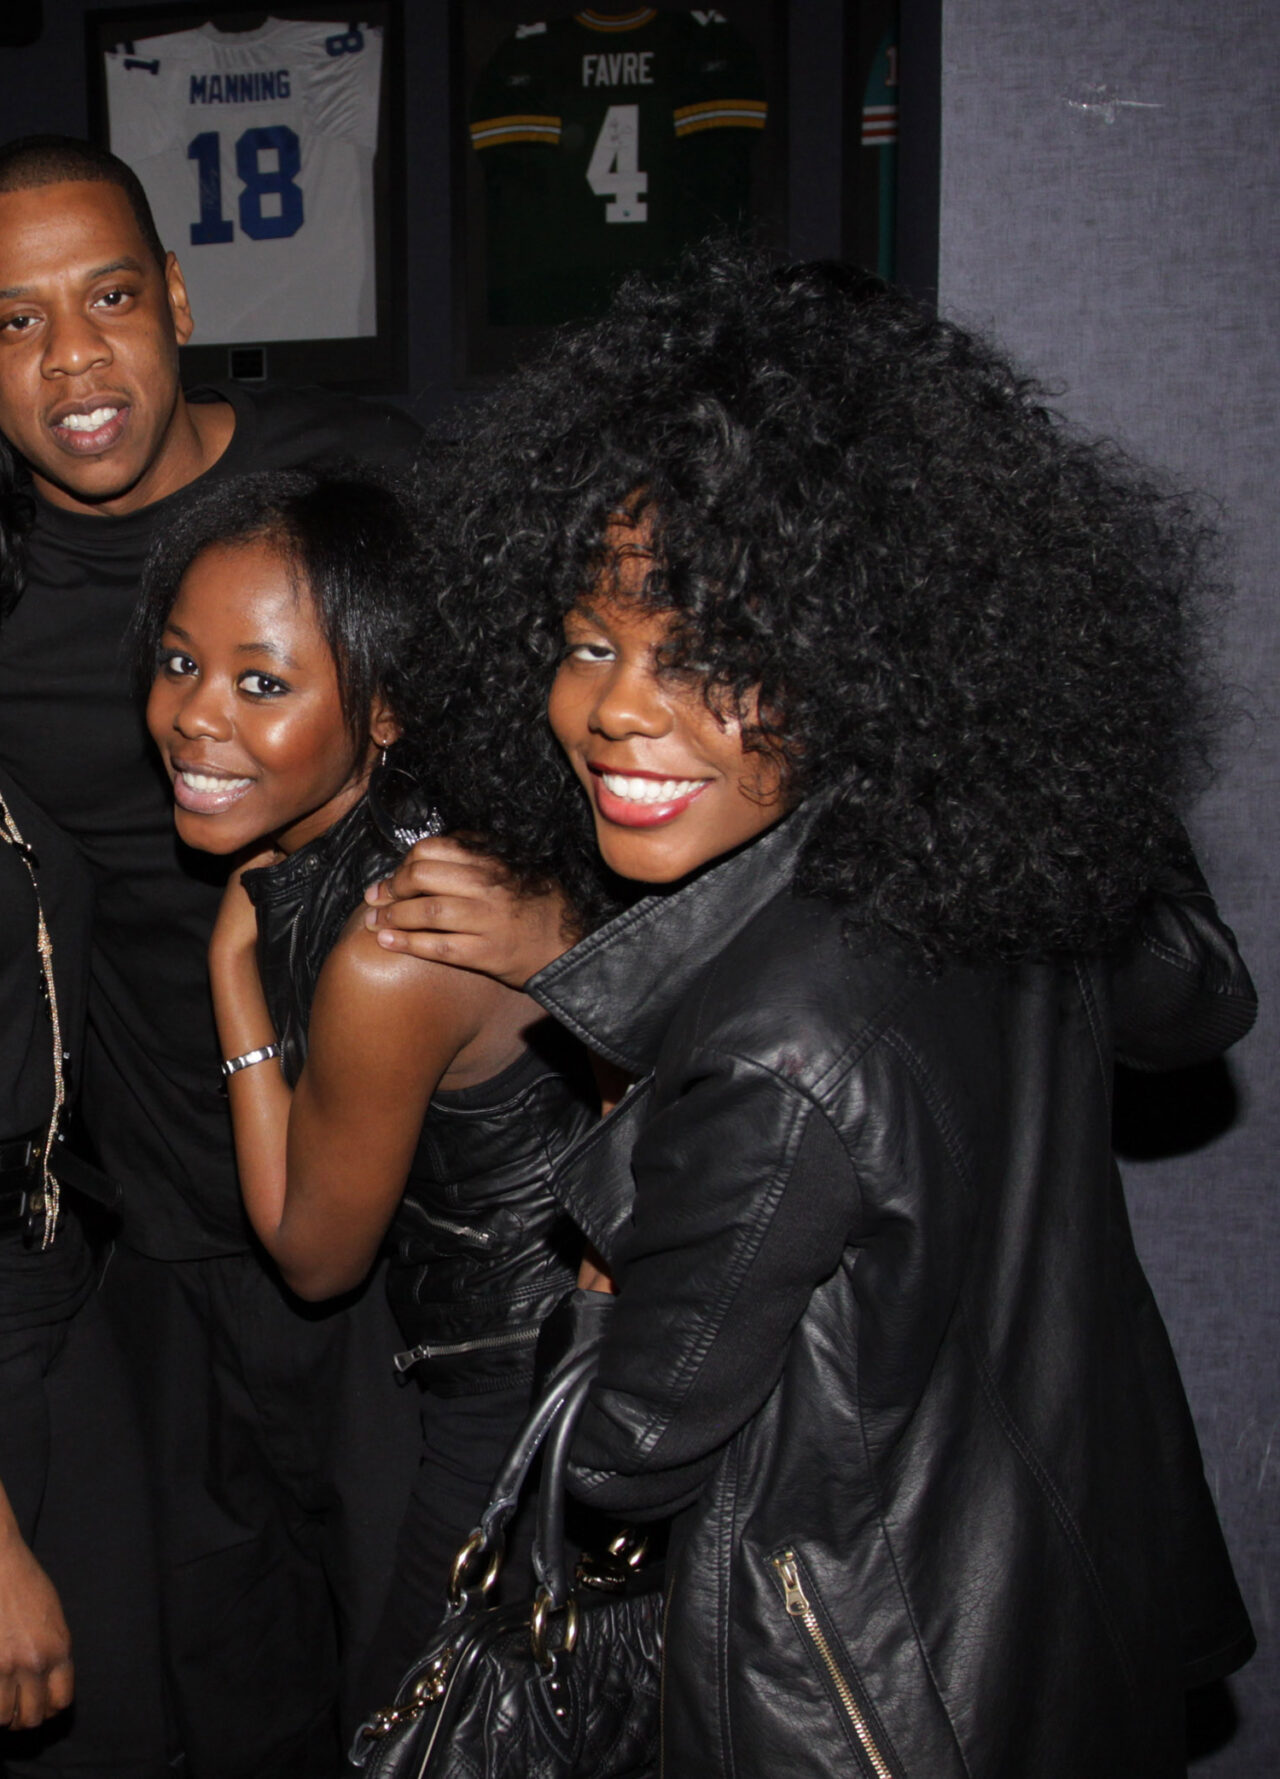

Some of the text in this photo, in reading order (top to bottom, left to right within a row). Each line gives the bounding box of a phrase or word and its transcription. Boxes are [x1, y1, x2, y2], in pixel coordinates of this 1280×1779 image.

[190, 70, 291, 104] MANNING
[582, 52, 654, 87] FAVRE
[187, 125, 304, 245] 18
[586, 104, 648, 223] 4
